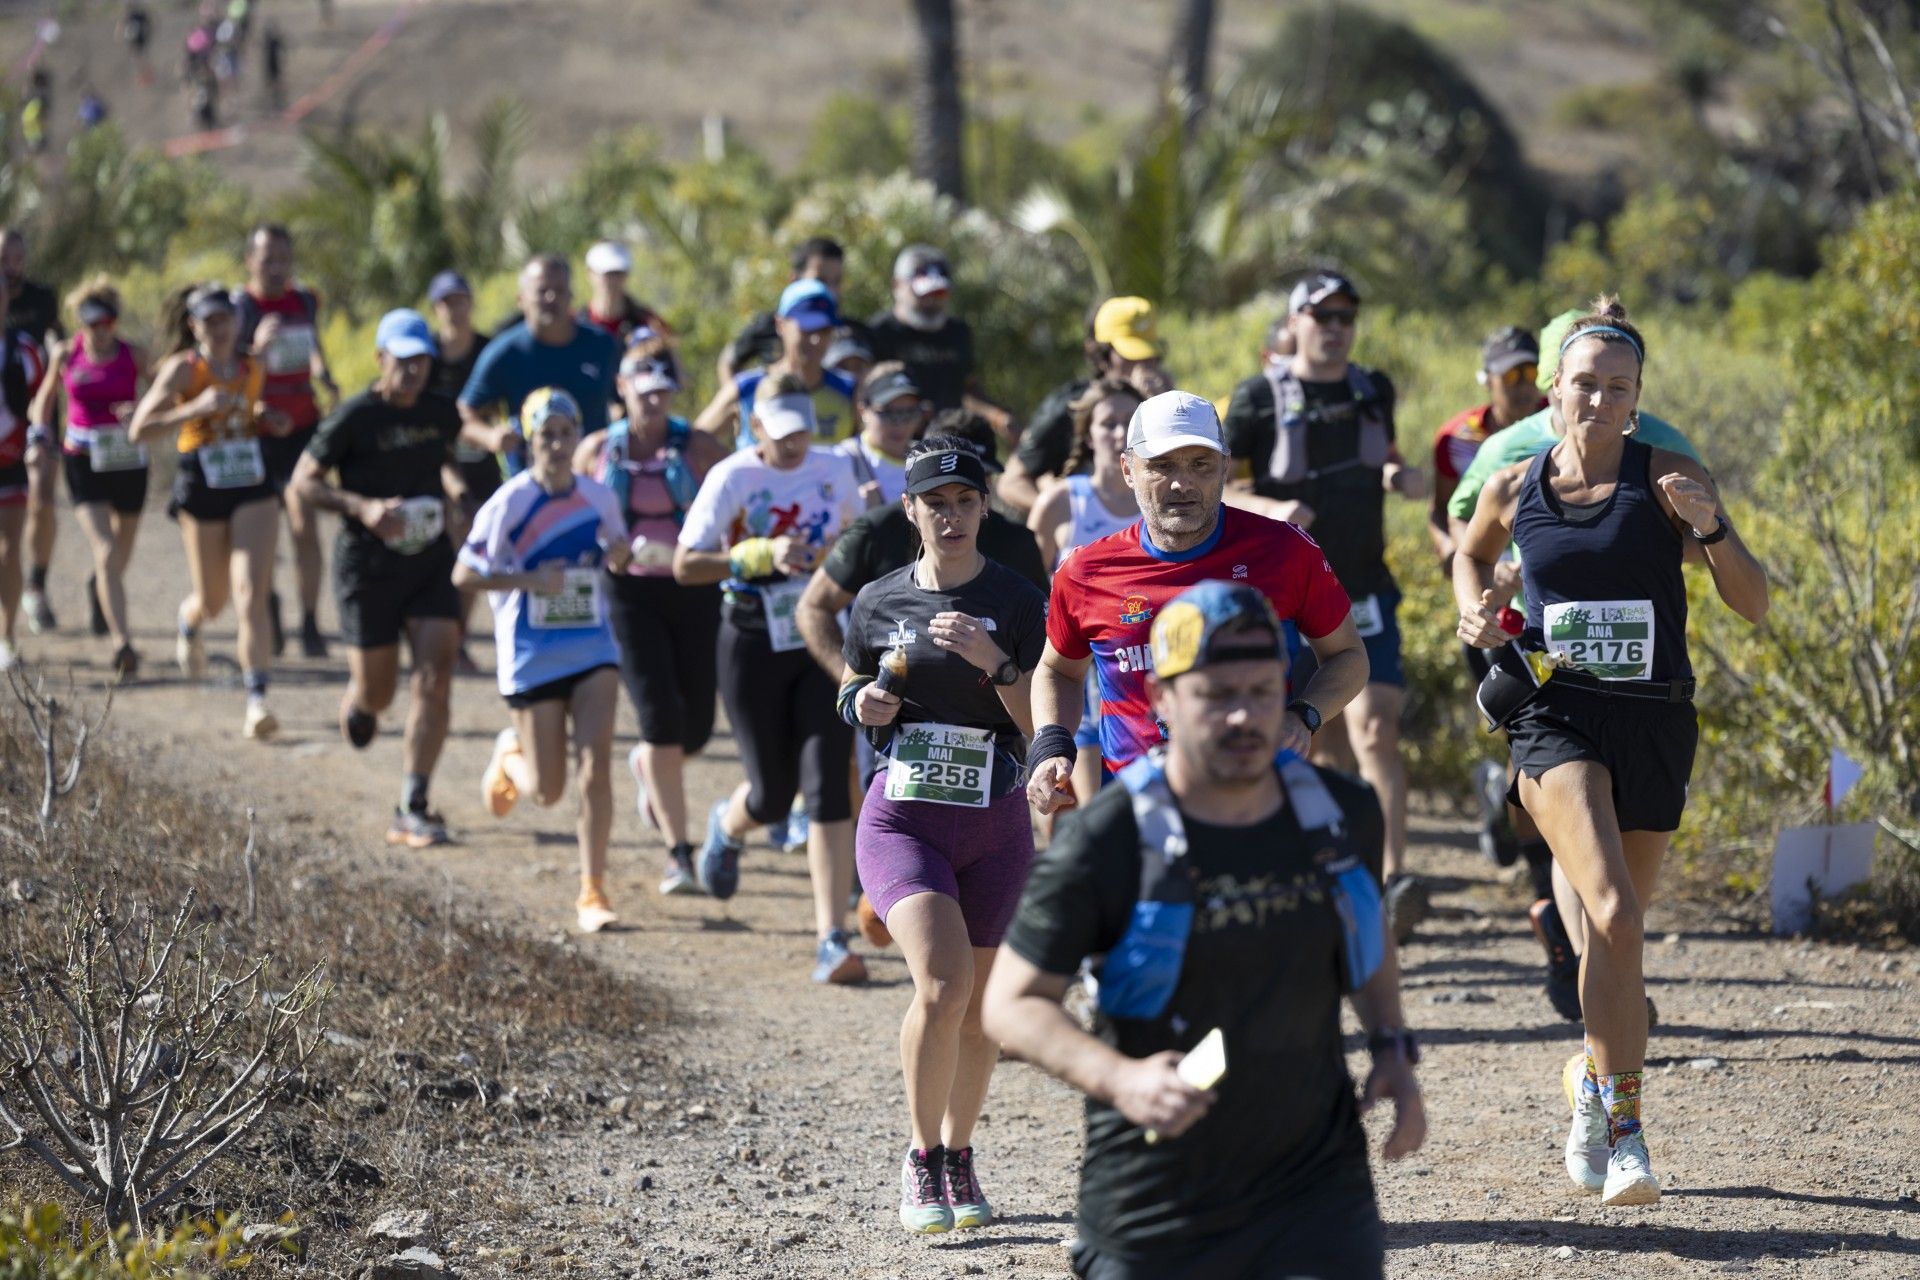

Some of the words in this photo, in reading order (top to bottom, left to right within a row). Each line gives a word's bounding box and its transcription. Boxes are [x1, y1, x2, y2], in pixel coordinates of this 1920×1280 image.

[1587, 625, 1613, 638] ANA
[1570, 641, 1644, 662] 2176
[928, 746, 953, 761] MAI
[909, 762, 980, 789] 2258
